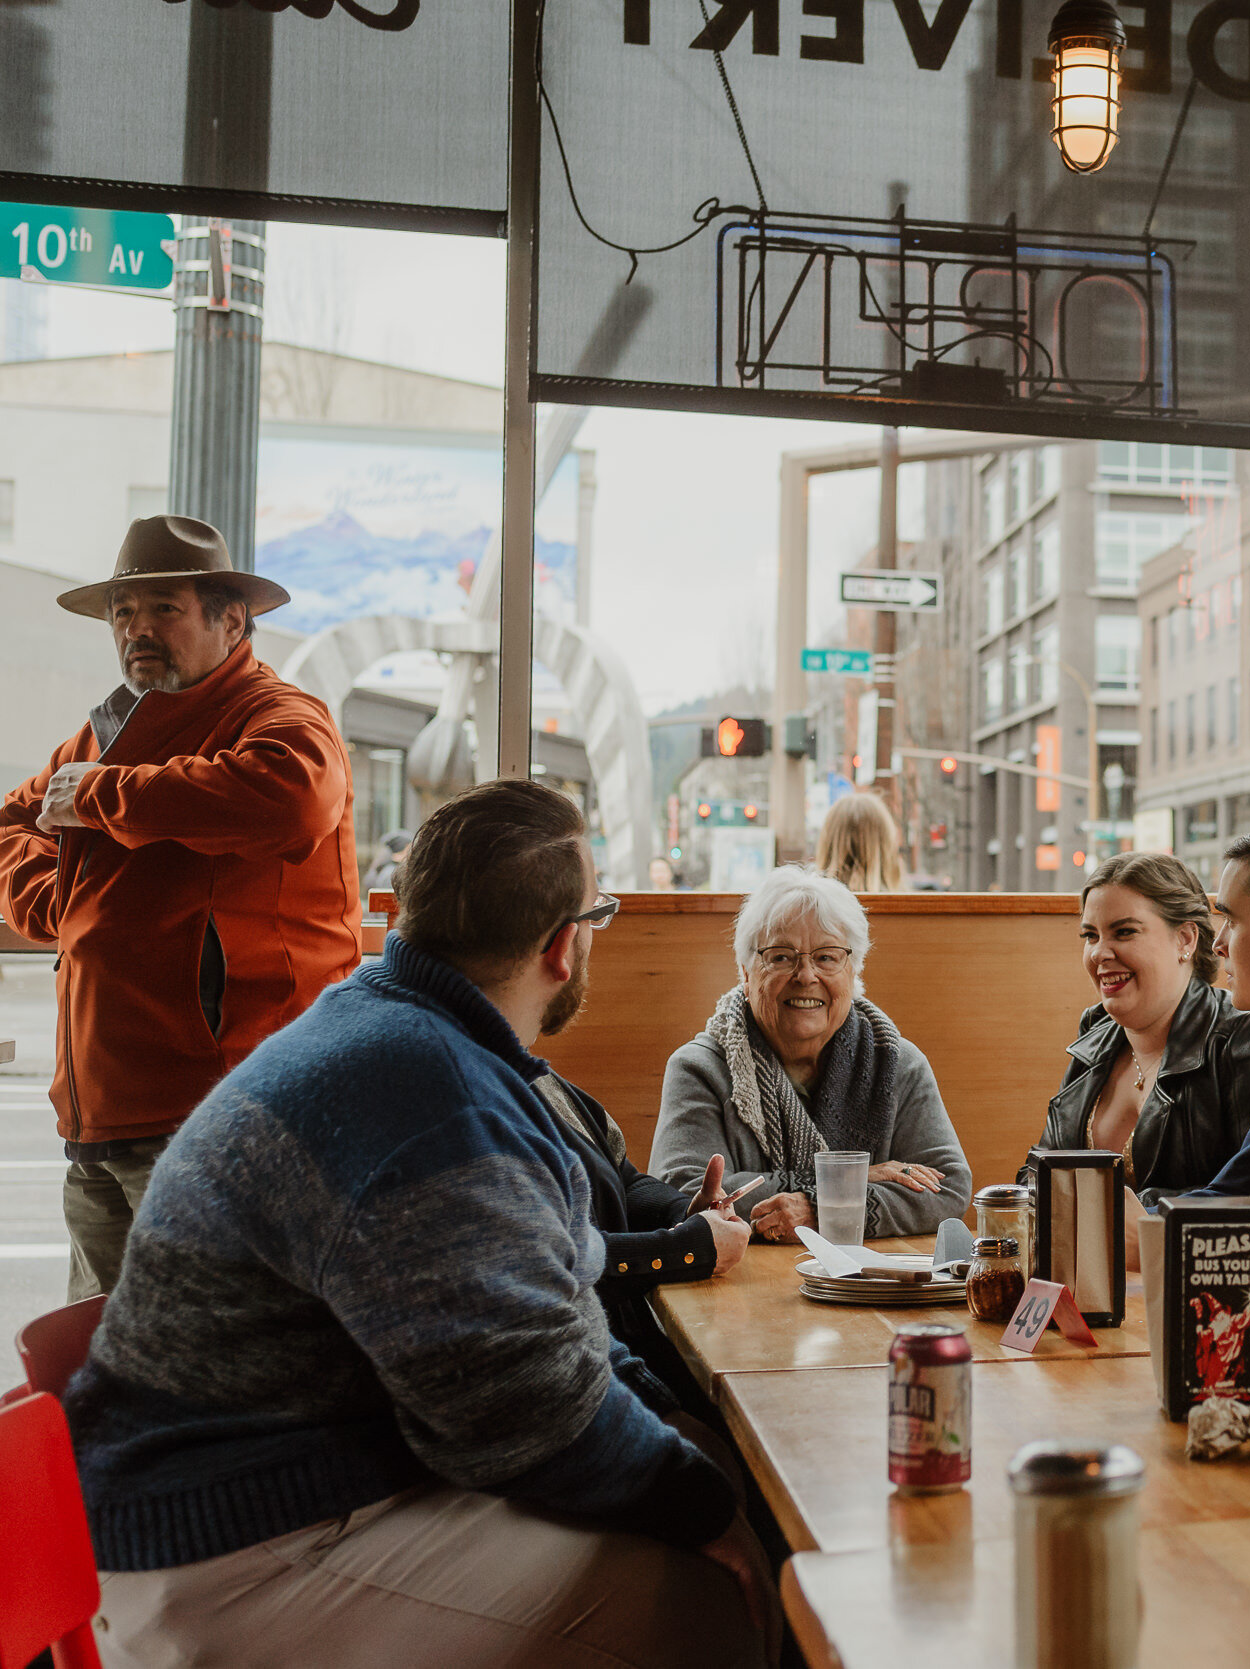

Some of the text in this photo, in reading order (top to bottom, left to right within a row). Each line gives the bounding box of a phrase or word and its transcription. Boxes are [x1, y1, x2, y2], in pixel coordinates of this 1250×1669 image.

[12, 222, 144, 275] 10th Av
[1195, 1260, 1219, 1271] BUS
[1190, 1274, 1223, 1285] OWN
[1014, 1296, 1050, 1339] 49
